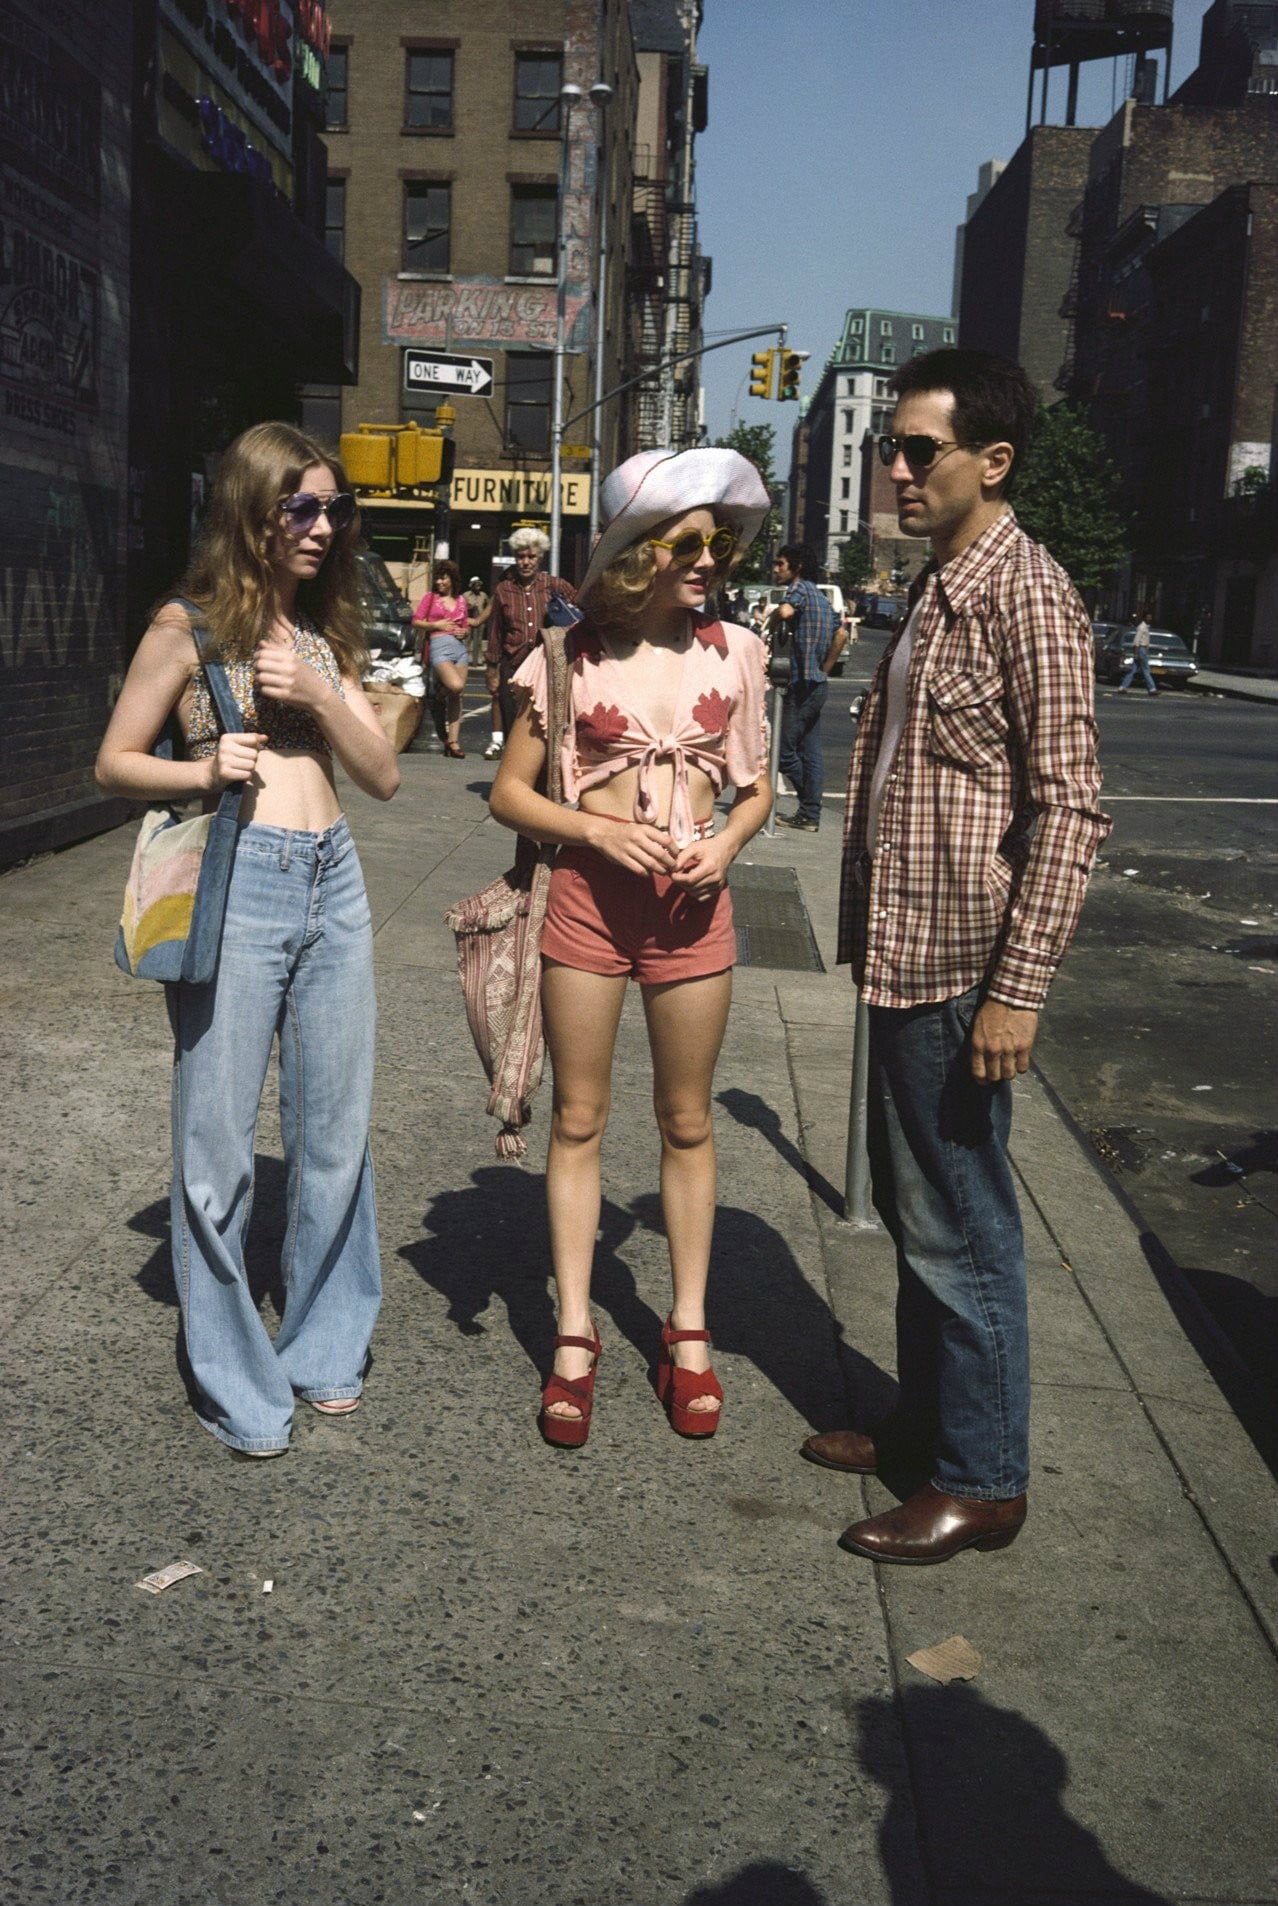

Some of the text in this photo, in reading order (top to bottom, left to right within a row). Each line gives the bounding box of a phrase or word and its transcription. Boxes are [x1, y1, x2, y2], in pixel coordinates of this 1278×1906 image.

[391, 286, 549, 329] PARKING
[453, 318, 485, 335] ON
[414, 363, 481, 384] ONE WAY
[454, 477, 578, 506] FURNITUE
